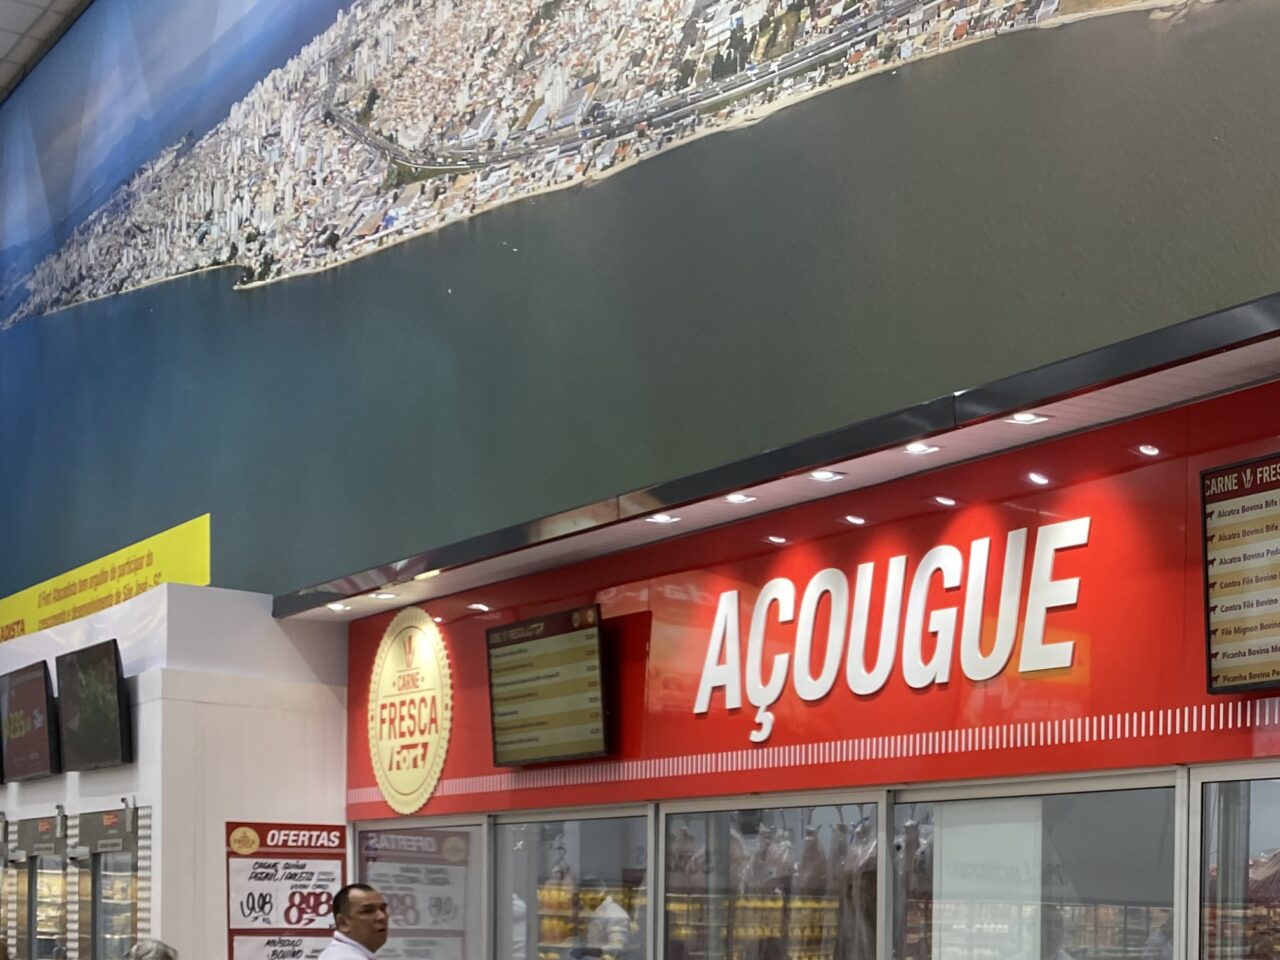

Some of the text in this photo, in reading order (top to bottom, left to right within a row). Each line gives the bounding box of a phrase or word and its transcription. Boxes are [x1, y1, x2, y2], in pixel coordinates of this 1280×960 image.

[1217, 508, 1240, 518] Alcatra
[1241, 501, 1263, 514] Bovina
[1265, 497, 1278, 508] Bife
[1218, 532, 1241, 543] Alcatra
[1242, 526, 1264, 538] Bovina
[1265, 522, 1279, 533] Bife
[1219, 555, 1241, 566] Alcatra
[1242, 550, 1265, 562] Bovina
[1220, 579, 1241, 590] Contra
[1255, 572, 1278, 584] Bovino
[1220, 603, 1242, 613] Contra
[1255, 596, 1278, 608] Bovino
[693, 516, 1091, 743] AÇOUGUE
[1234, 623, 1258, 636] Mignon
[1222, 650, 1247, 660] Picanha
[1248, 646, 1270, 657] Bovina
[398, 672, 420, 691] CARNE
[1222, 673, 1247, 683] Picanha
[1248, 669, 1271, 680] Bovina
[379, 695, 439, 741] FRESCA
[266, 829, 341, 847] OFERTAS
